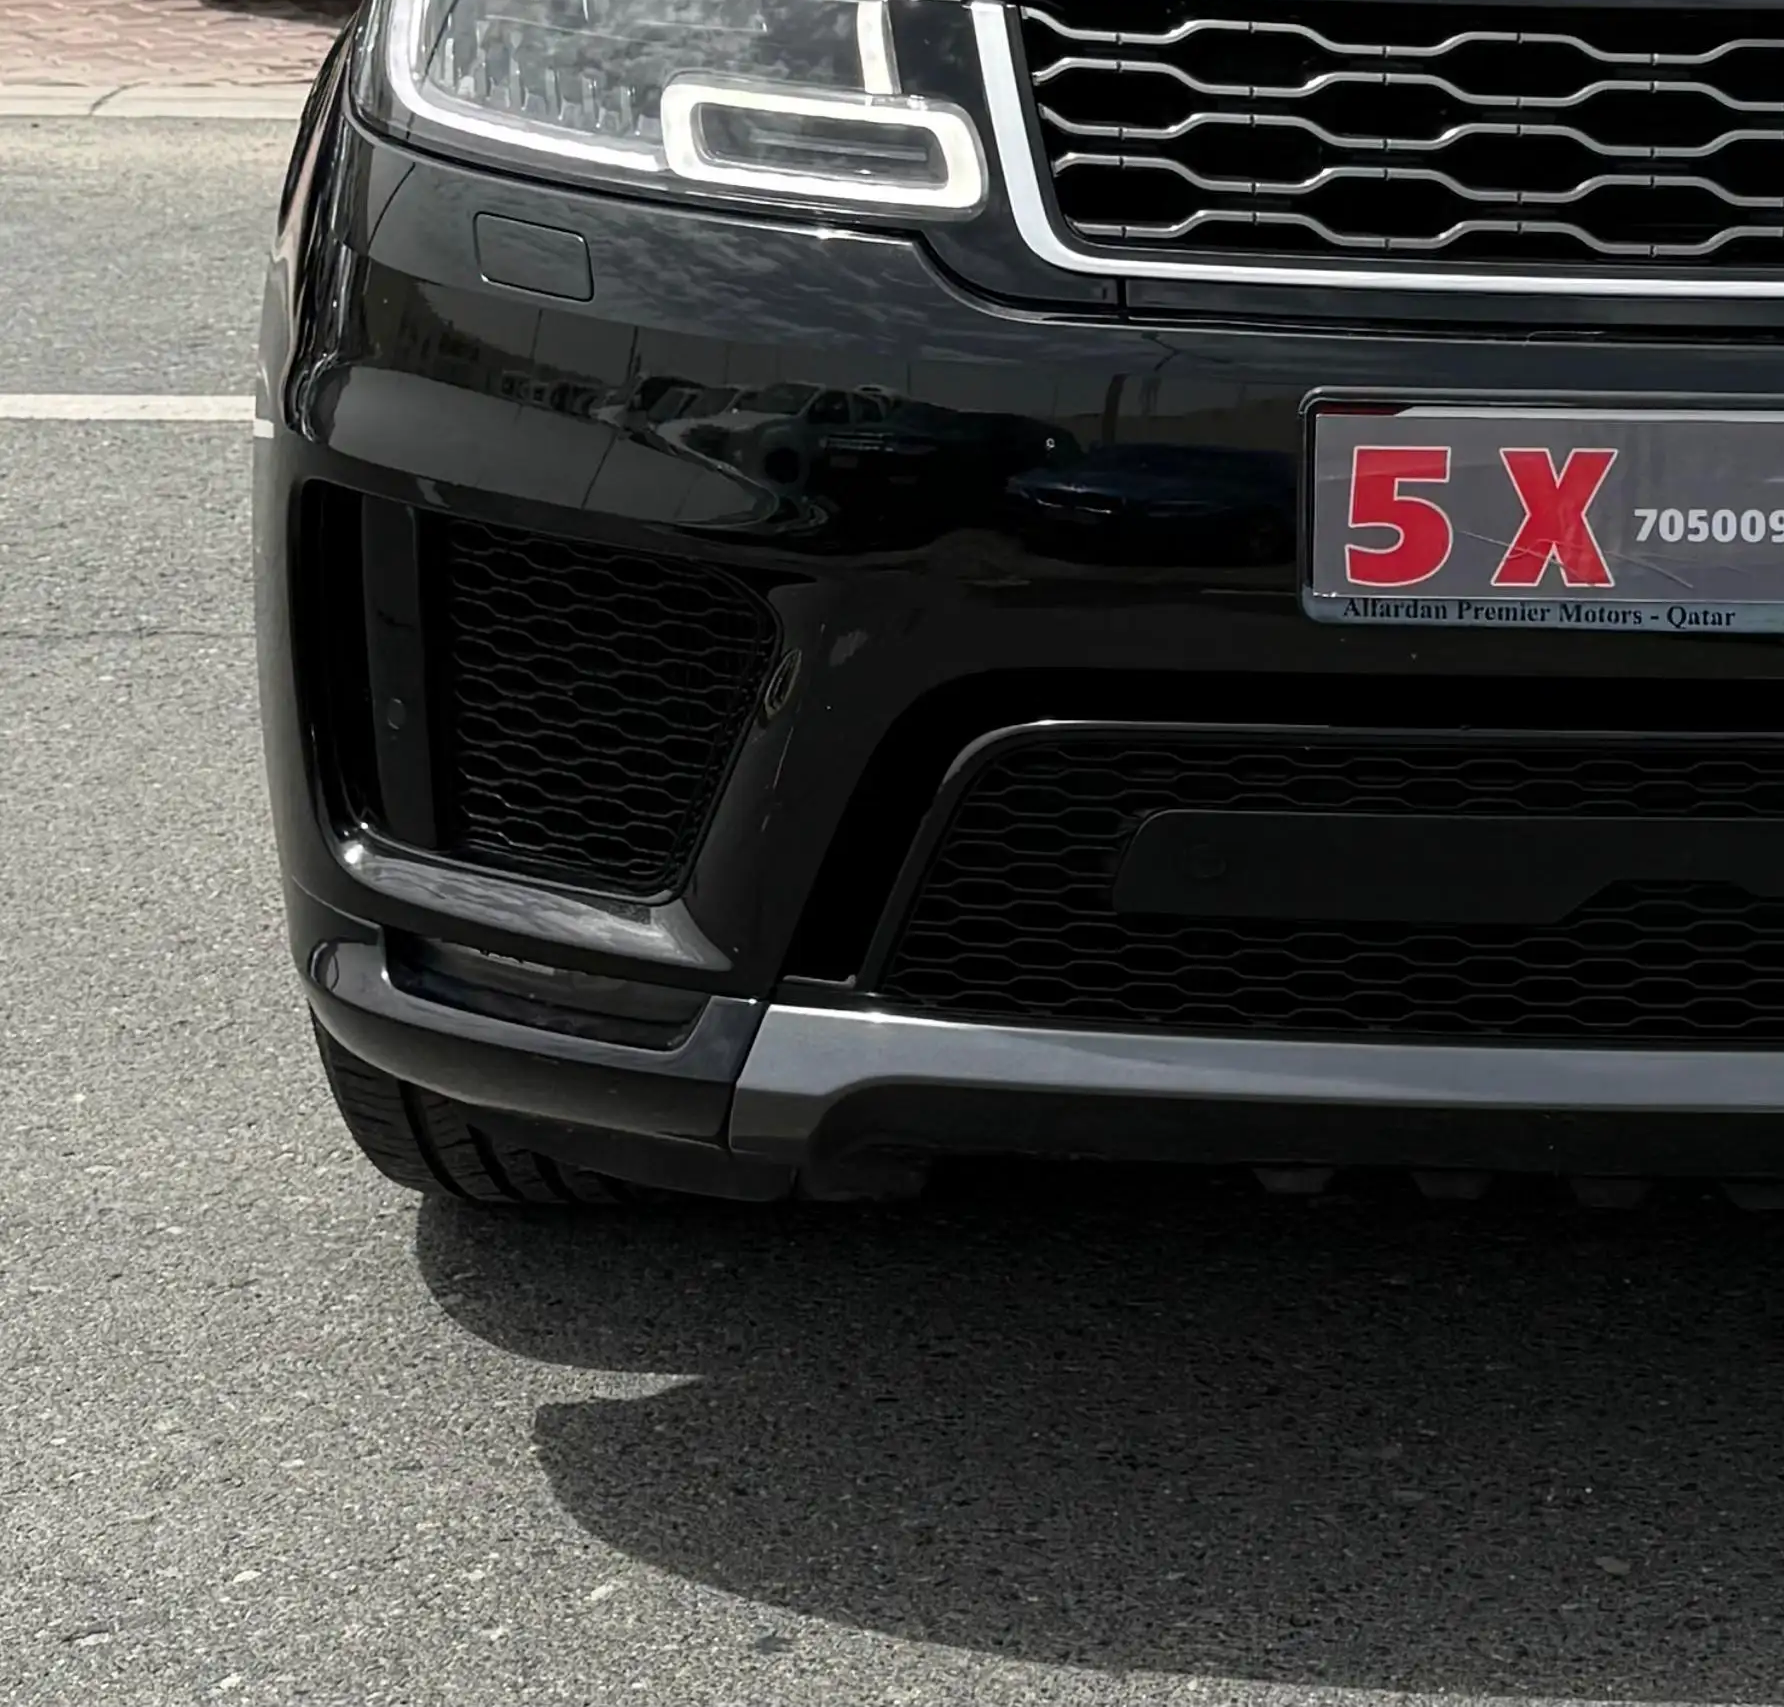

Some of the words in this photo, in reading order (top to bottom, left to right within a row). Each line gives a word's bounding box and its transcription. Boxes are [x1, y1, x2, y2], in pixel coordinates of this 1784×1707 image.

[1344, 445, 1454, 588] 5
[1490, 447, 1619, 588] X
[1343, 597, 1448, 621] Alfardan
[1456, 601, 1550, 624] Premier
[1559, 603, 1644, 626] Motors
[1666, 604, 1736, 631] Qatar
